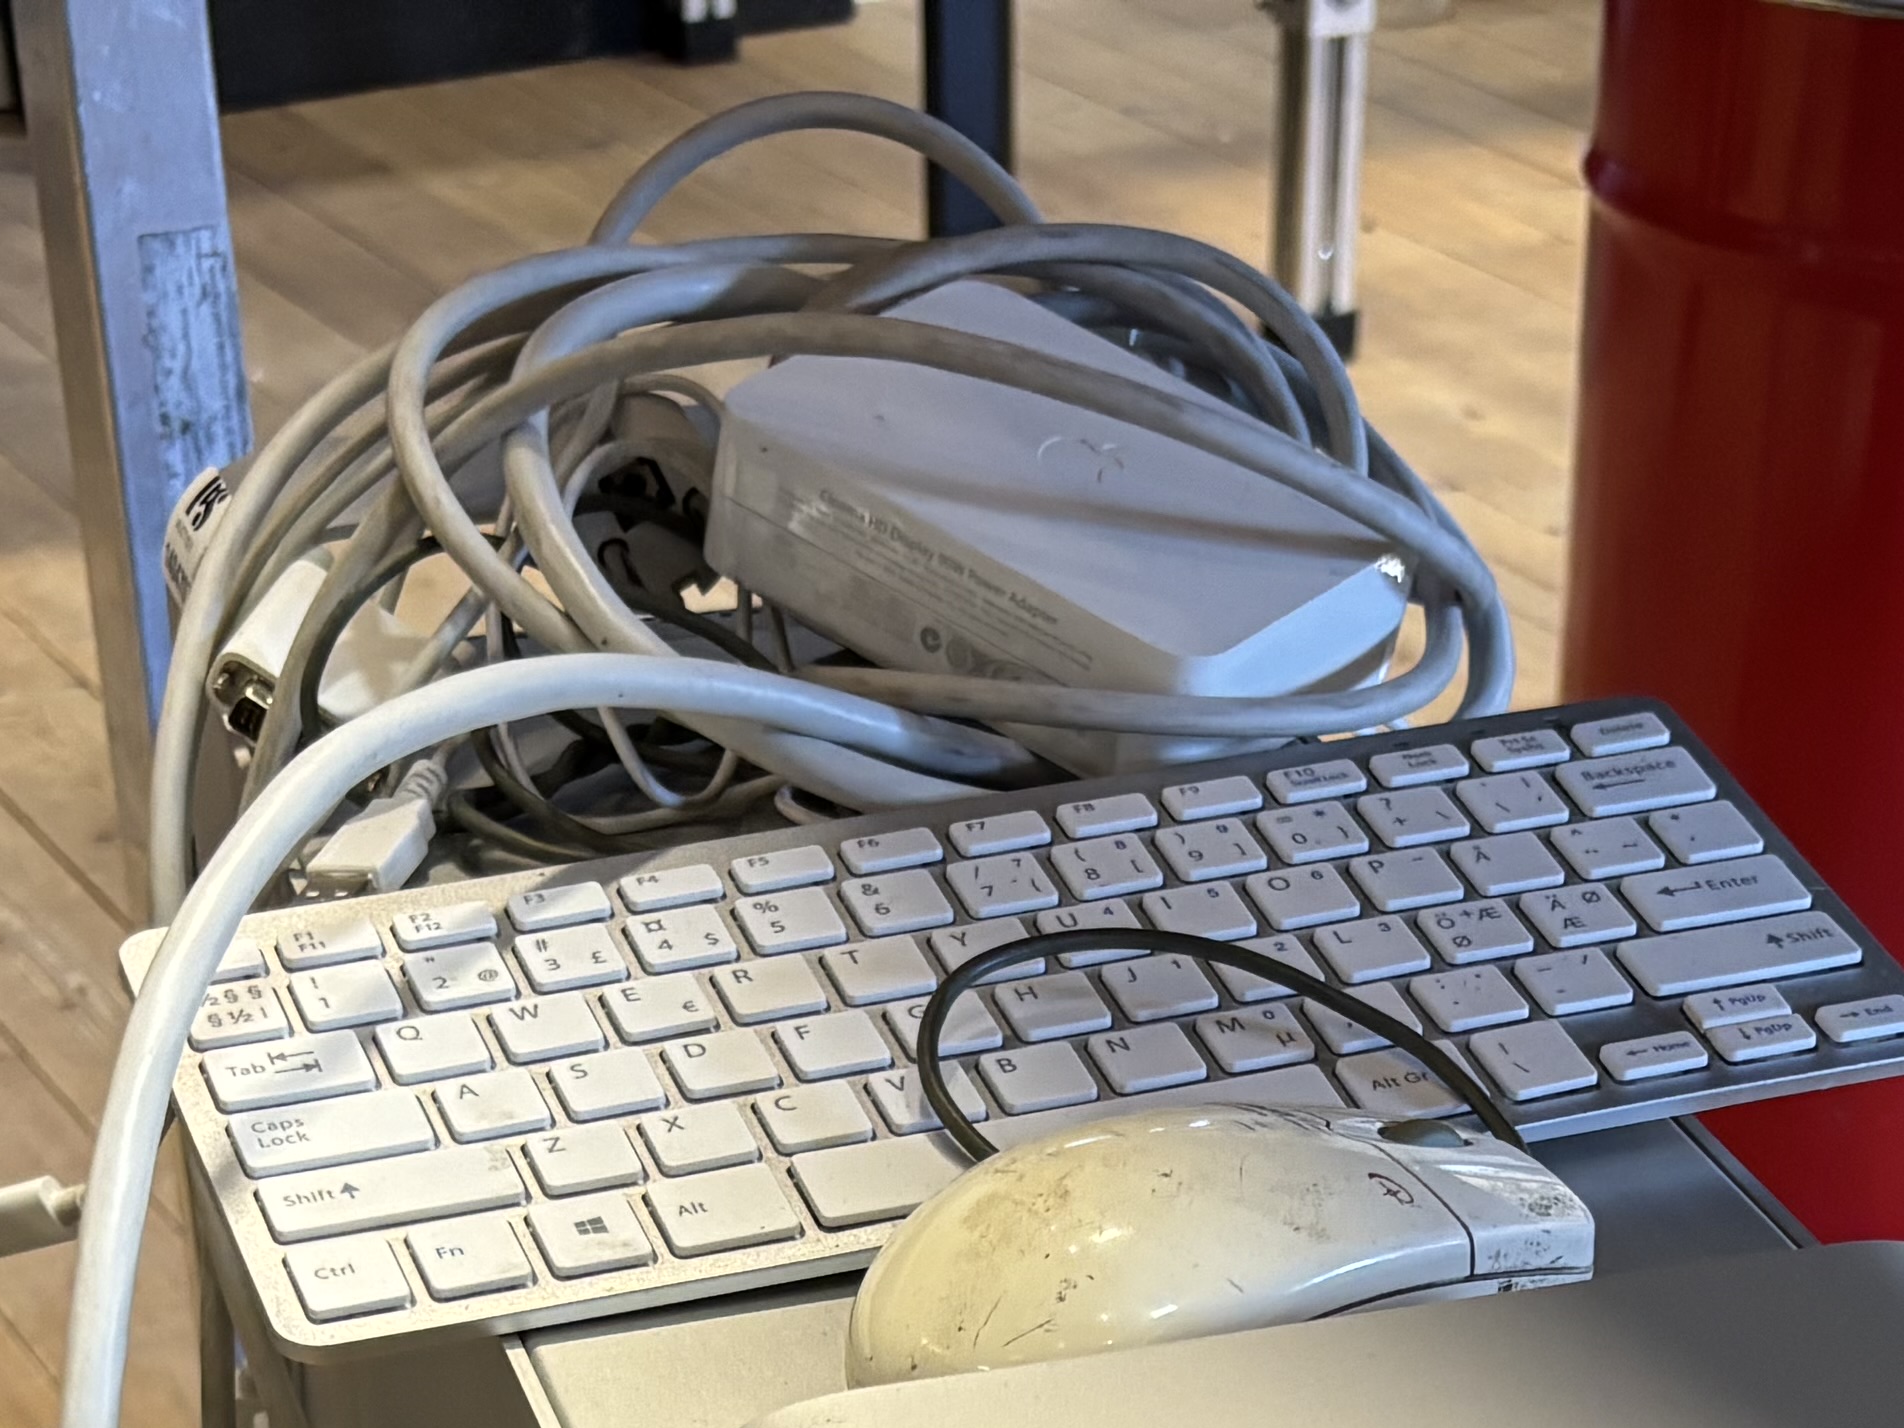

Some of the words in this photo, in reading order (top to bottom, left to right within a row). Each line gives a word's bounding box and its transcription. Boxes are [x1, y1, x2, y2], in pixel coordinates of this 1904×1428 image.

[890, 523, 934, 561] Display
[1283, 767, 1315, 780] F10
[1580, 758, 1677, 782] Backspace
[1179, 785, 1200, 797] F9
[965, 820, 986, 833] F7
[747, 855, 770, 869] F5
[1188, 849, 1204, 863] 9
[1084, 867, 1101, 881] 8
[1368, 859, 1385, 875] P
[636, 874, 660, 887] F4
[1704, 874, 1760, 892] Enter
[861, 882, 881, 897] &
[980, 884, 994, 899] 7
[1206, 887, 1220, 900] 5
[523, 893, 546, 906] F3
[753, 899, 780, 914] %
[408, 911, 432, 924] F2
[874, 902, 891, 916] 6
[414, 921, 443, 933] F12
[771, 920, 787, 935] 5
[1055, 912, 1079, 929] U
[293, 931, 313, 942] F1
[704, 931, 720, 946] $
[949, 931, 968, 947] Y
[1333, 929, 1352, 946] L
[1785, 926, 1835, 945] Shift
[657, 938, 674, 951] 4
[545, 958, 562, 971] 3
[591, 949, 608, 965] £
[840, 949, 859, 966] T
[433, 976, 450, 990] 2
[732, 968, 755, 985] R
[1126, 966, 1137, 983] J
[621, 986, 642, 1003] E
[1014, 985, 1040, 1003] H
[1728, 993, 1767, 1009] PgUp
[317, 996, 330, 1010] 1
[682, 999, 699, 1014] €
[1864, 1003, 1894, 1017] End
[509, 1003, 539, 1021] W
[395, 1024, 424, 1042] Q
[792, 1024, 811, 1041] F
[1215, 1017, 1246, 1035] M
[682, 1042, 707, 1060] D
[1105, 1036, 1131, 1054] N
[1651, 1040, 1693, 1054] Home
[225, 1062, 267, 1079] Tab
[569, 1063, 589, 1080] S
[996, 1057, 1018, 1075] B
[885, 1074, 906, 1092] V
[1370, 1071, 1402, 1091] Alt
[1403, 1070, 1429, 1086] Gr
[458, 1083, 480, 1100] A
[773, 1095, 799, 1112] C
[249, 1117, 306, 1135] Caps
[662, 1115, 685, 1133] X
[258, 1131, 311, 1149] Lock
[542, 1136, 567, 1155] Z
[281, 1186, 337, 1208] Shift
[677, 1200, 709, 1218] Alt
[435, 1245, 465, 1261] Fn
[313, 1263, 357, 1281] Ctrl
